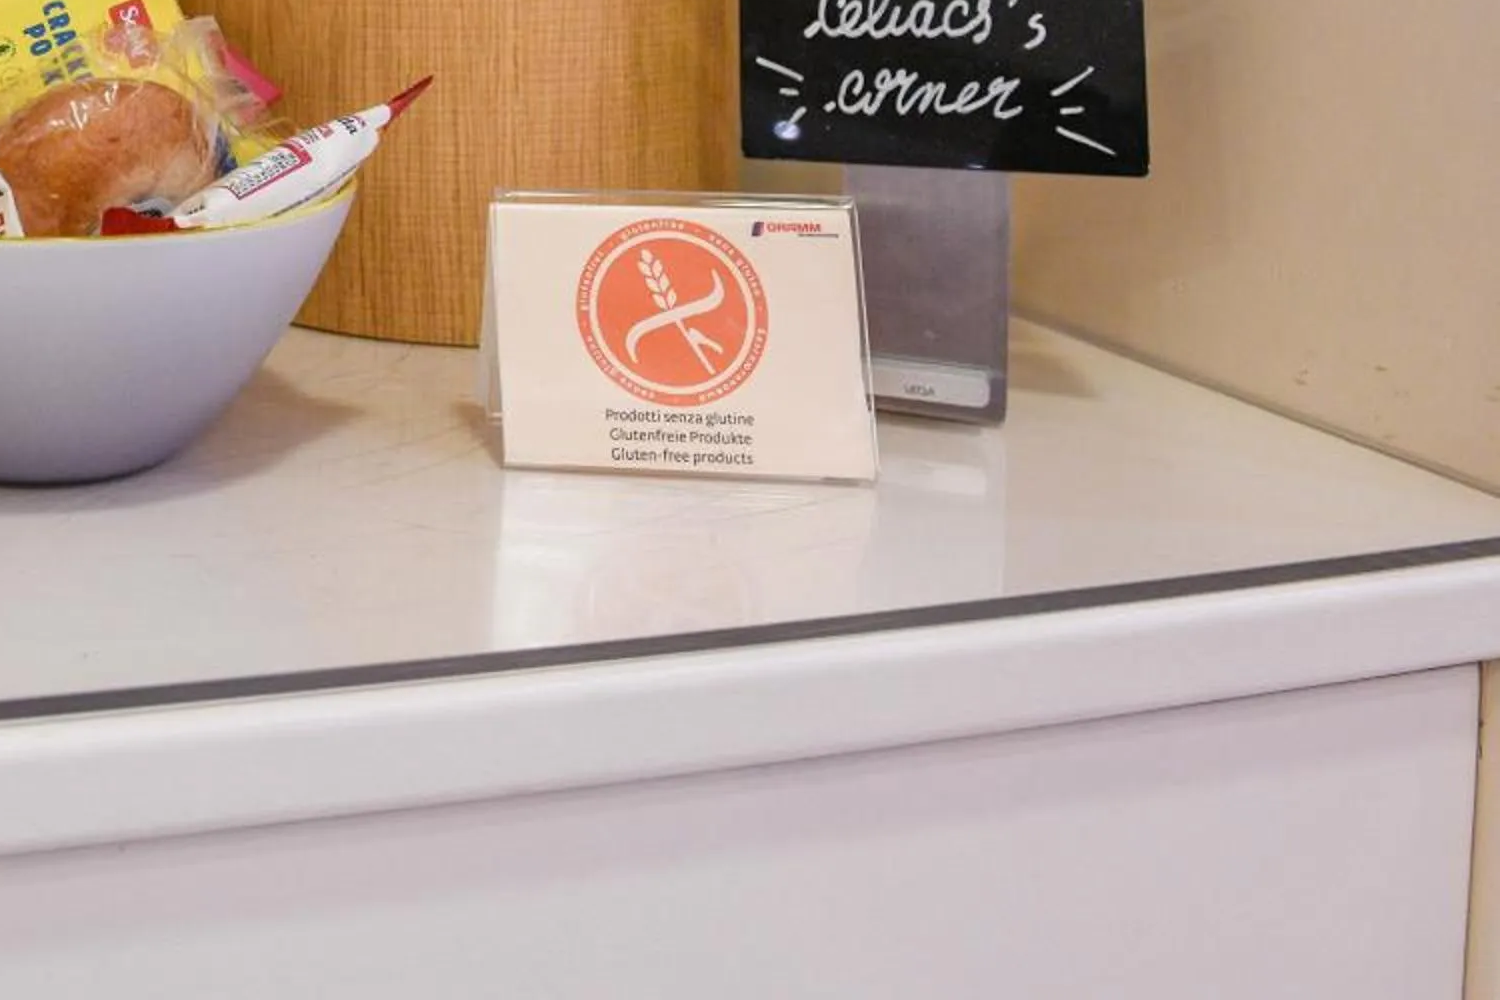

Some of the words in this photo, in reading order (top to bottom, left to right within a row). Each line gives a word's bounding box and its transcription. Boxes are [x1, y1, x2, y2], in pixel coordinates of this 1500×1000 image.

[605, 409, 661, 423] Prodotti
[663, 414, 703, 424] senza
[705, 412, 755, 428] glutine
[609, 428, 687, 443] Glutenfreie
[689, 431, 753, 445] Produkte
[611, 447, 690, 463] Gluten-free
[693, 450, 754, 466] products
